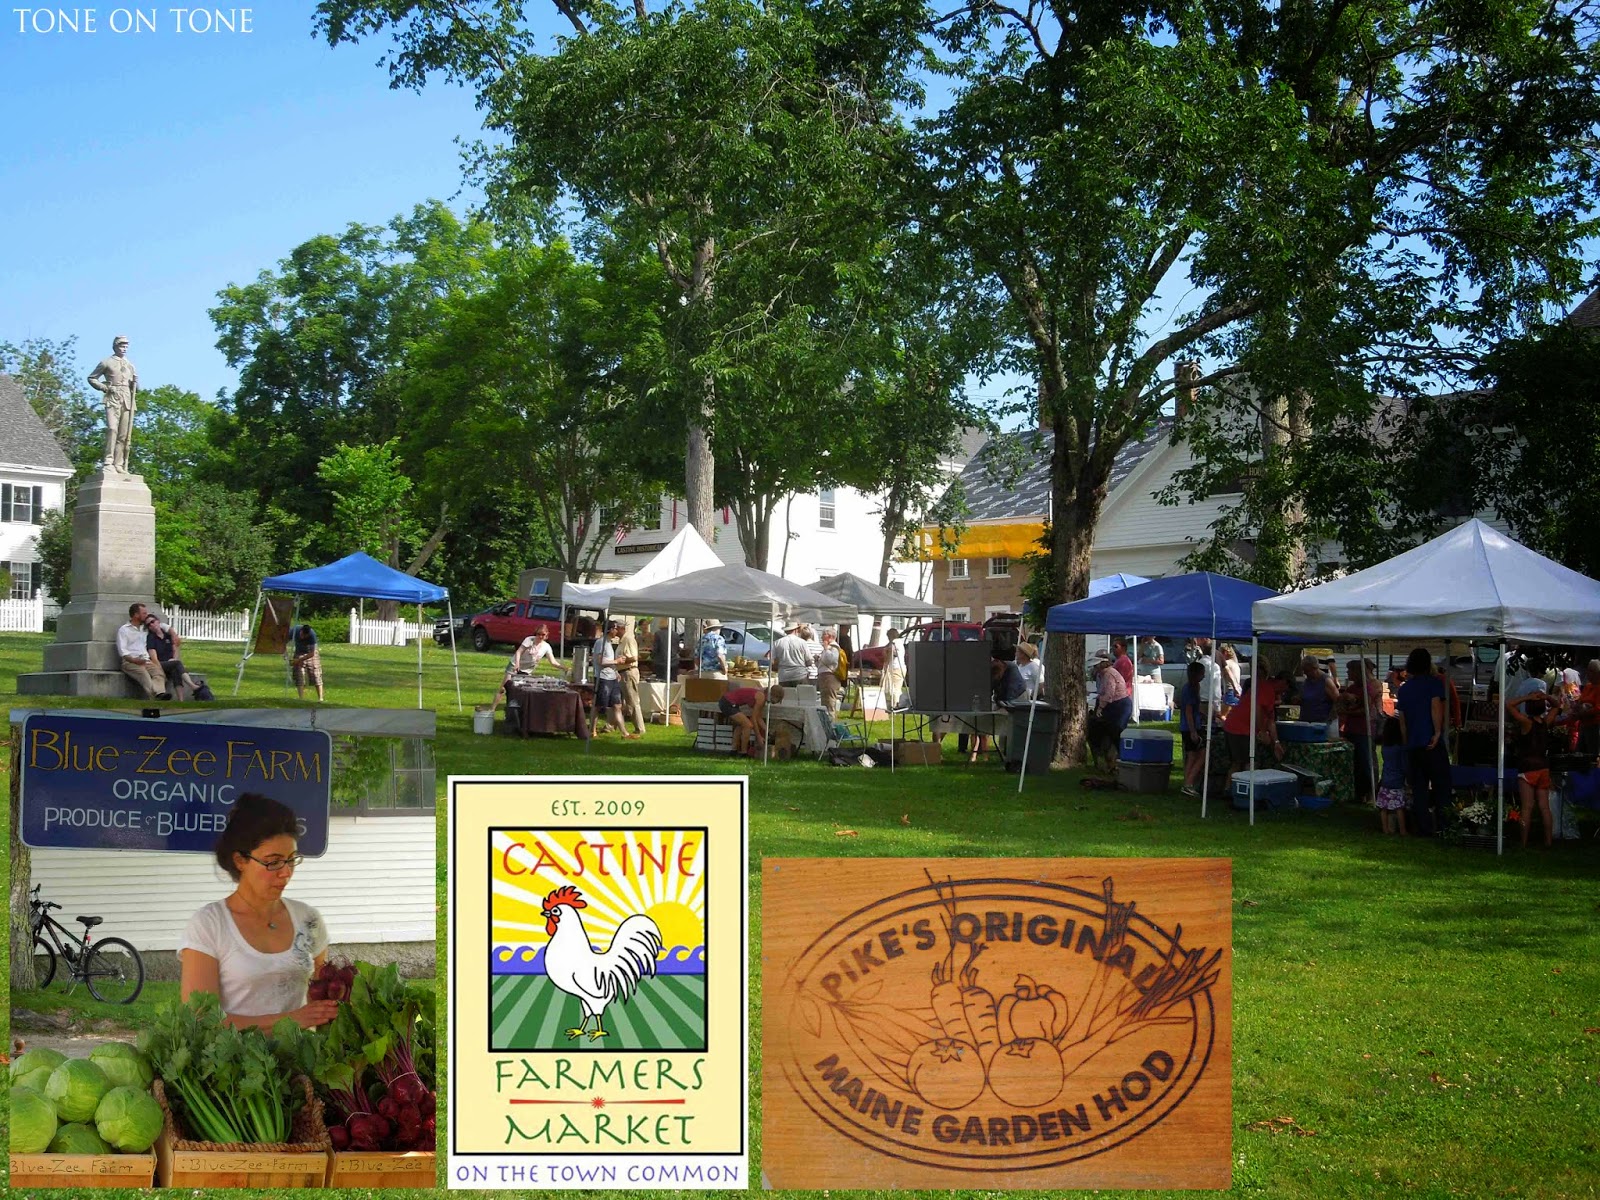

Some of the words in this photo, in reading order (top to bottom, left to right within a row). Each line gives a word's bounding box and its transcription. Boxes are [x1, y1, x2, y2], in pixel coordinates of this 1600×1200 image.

[225, 740, 322, 784] FARM
[112, 778, 236, 805] ORGANIC
[551, 800, 587, 817] EST.
[594, 800, 646, 817] 2009
[44, 806, 141, 831] PRODUCE
[502, 840, 697, 877] CASTINE
[820, 918, 936, 1001] PIKE'S
[950, 911, 1170, 996] ORIGINAL
[495, 1057, 707, 1093] FARMERS
[813, 1052, 924, 1136] MAINE
[932, 1102, 1090, 1147] GARDEN
[1091, 1049, 1175, 1122] HOD
[504, 1113, 695, 1146] MARKET
[456, 1165, 488, 1182] ON
[497, 1165, 539, 1182] THE
[547, 1165, 617, 1182] TOWN
[627, 1164, 739, 1182] COMMON
